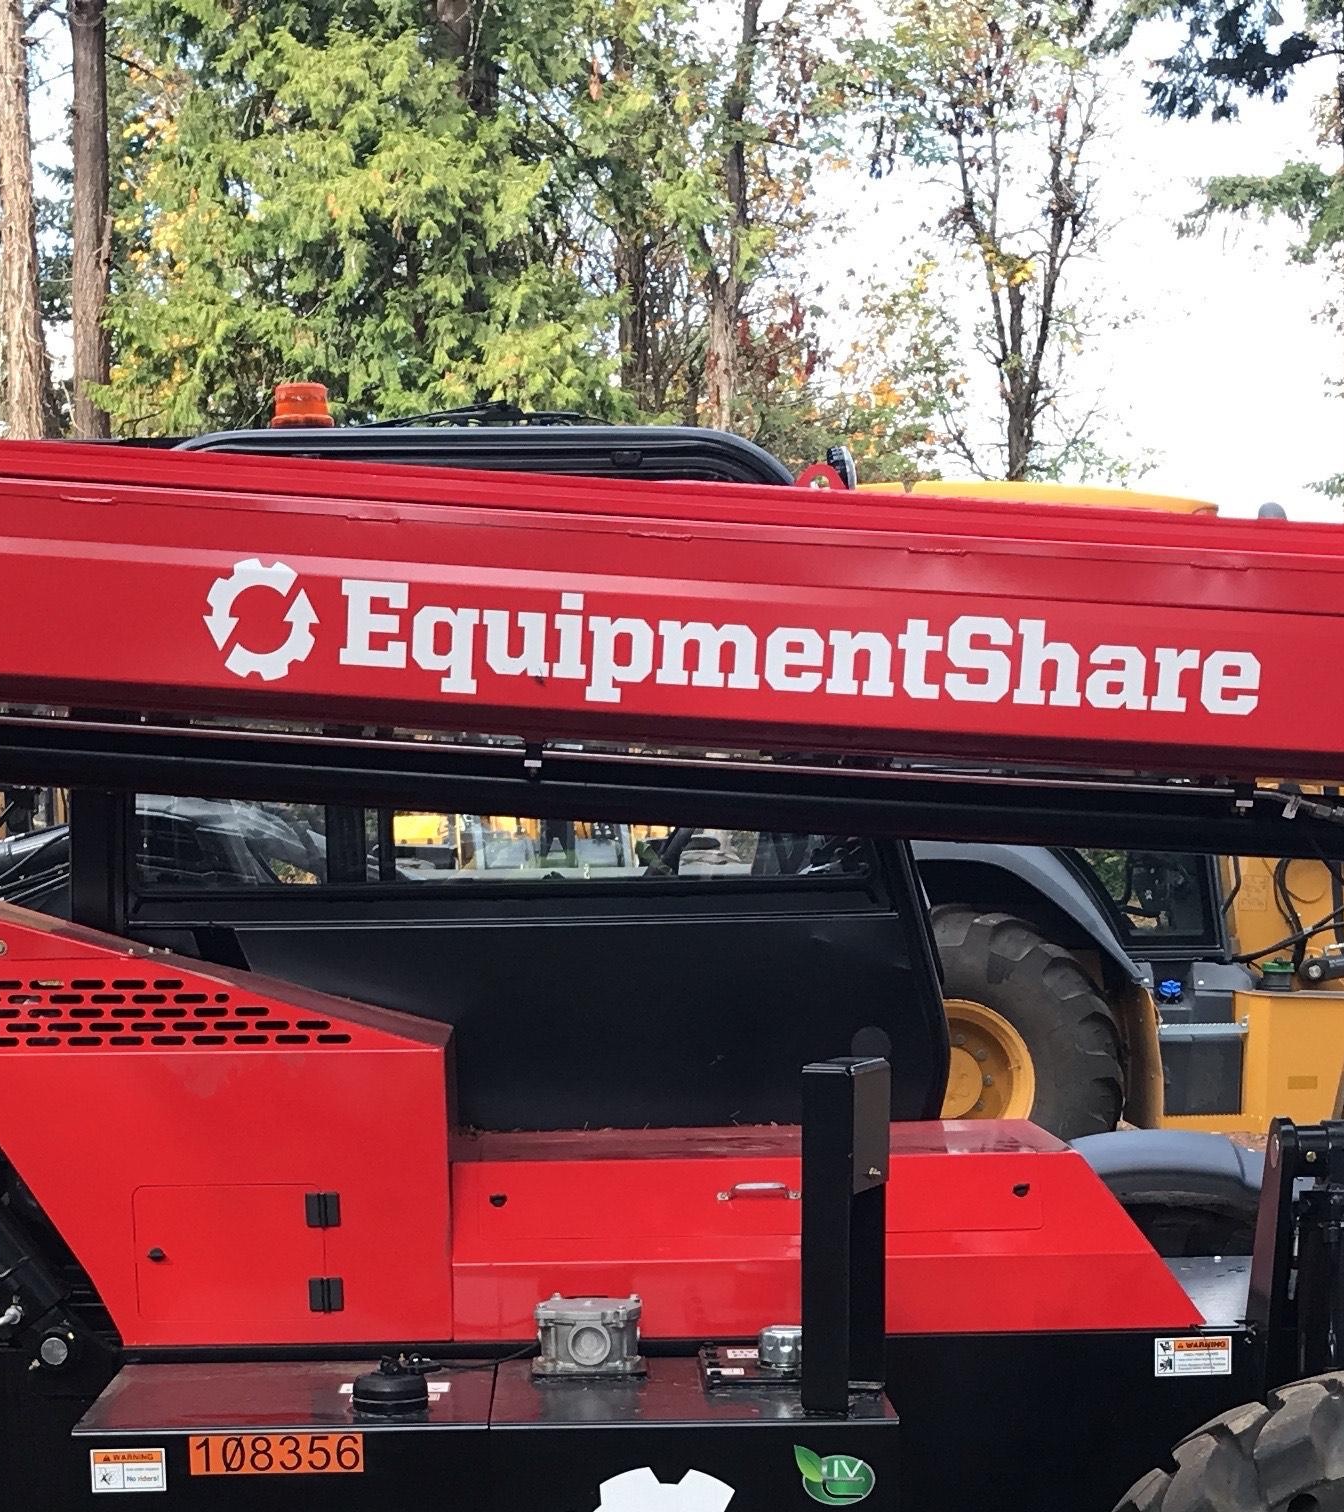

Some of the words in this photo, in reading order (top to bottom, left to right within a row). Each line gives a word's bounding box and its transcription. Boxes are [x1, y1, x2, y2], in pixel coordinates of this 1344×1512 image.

[338, 578, 1262, 716] EquipmentShare
[1185, 1340, 1226, 1349] WARNING
[112, 1453, 154, 1461] WARNING
[195, 1435, 361, 1473] 108356
